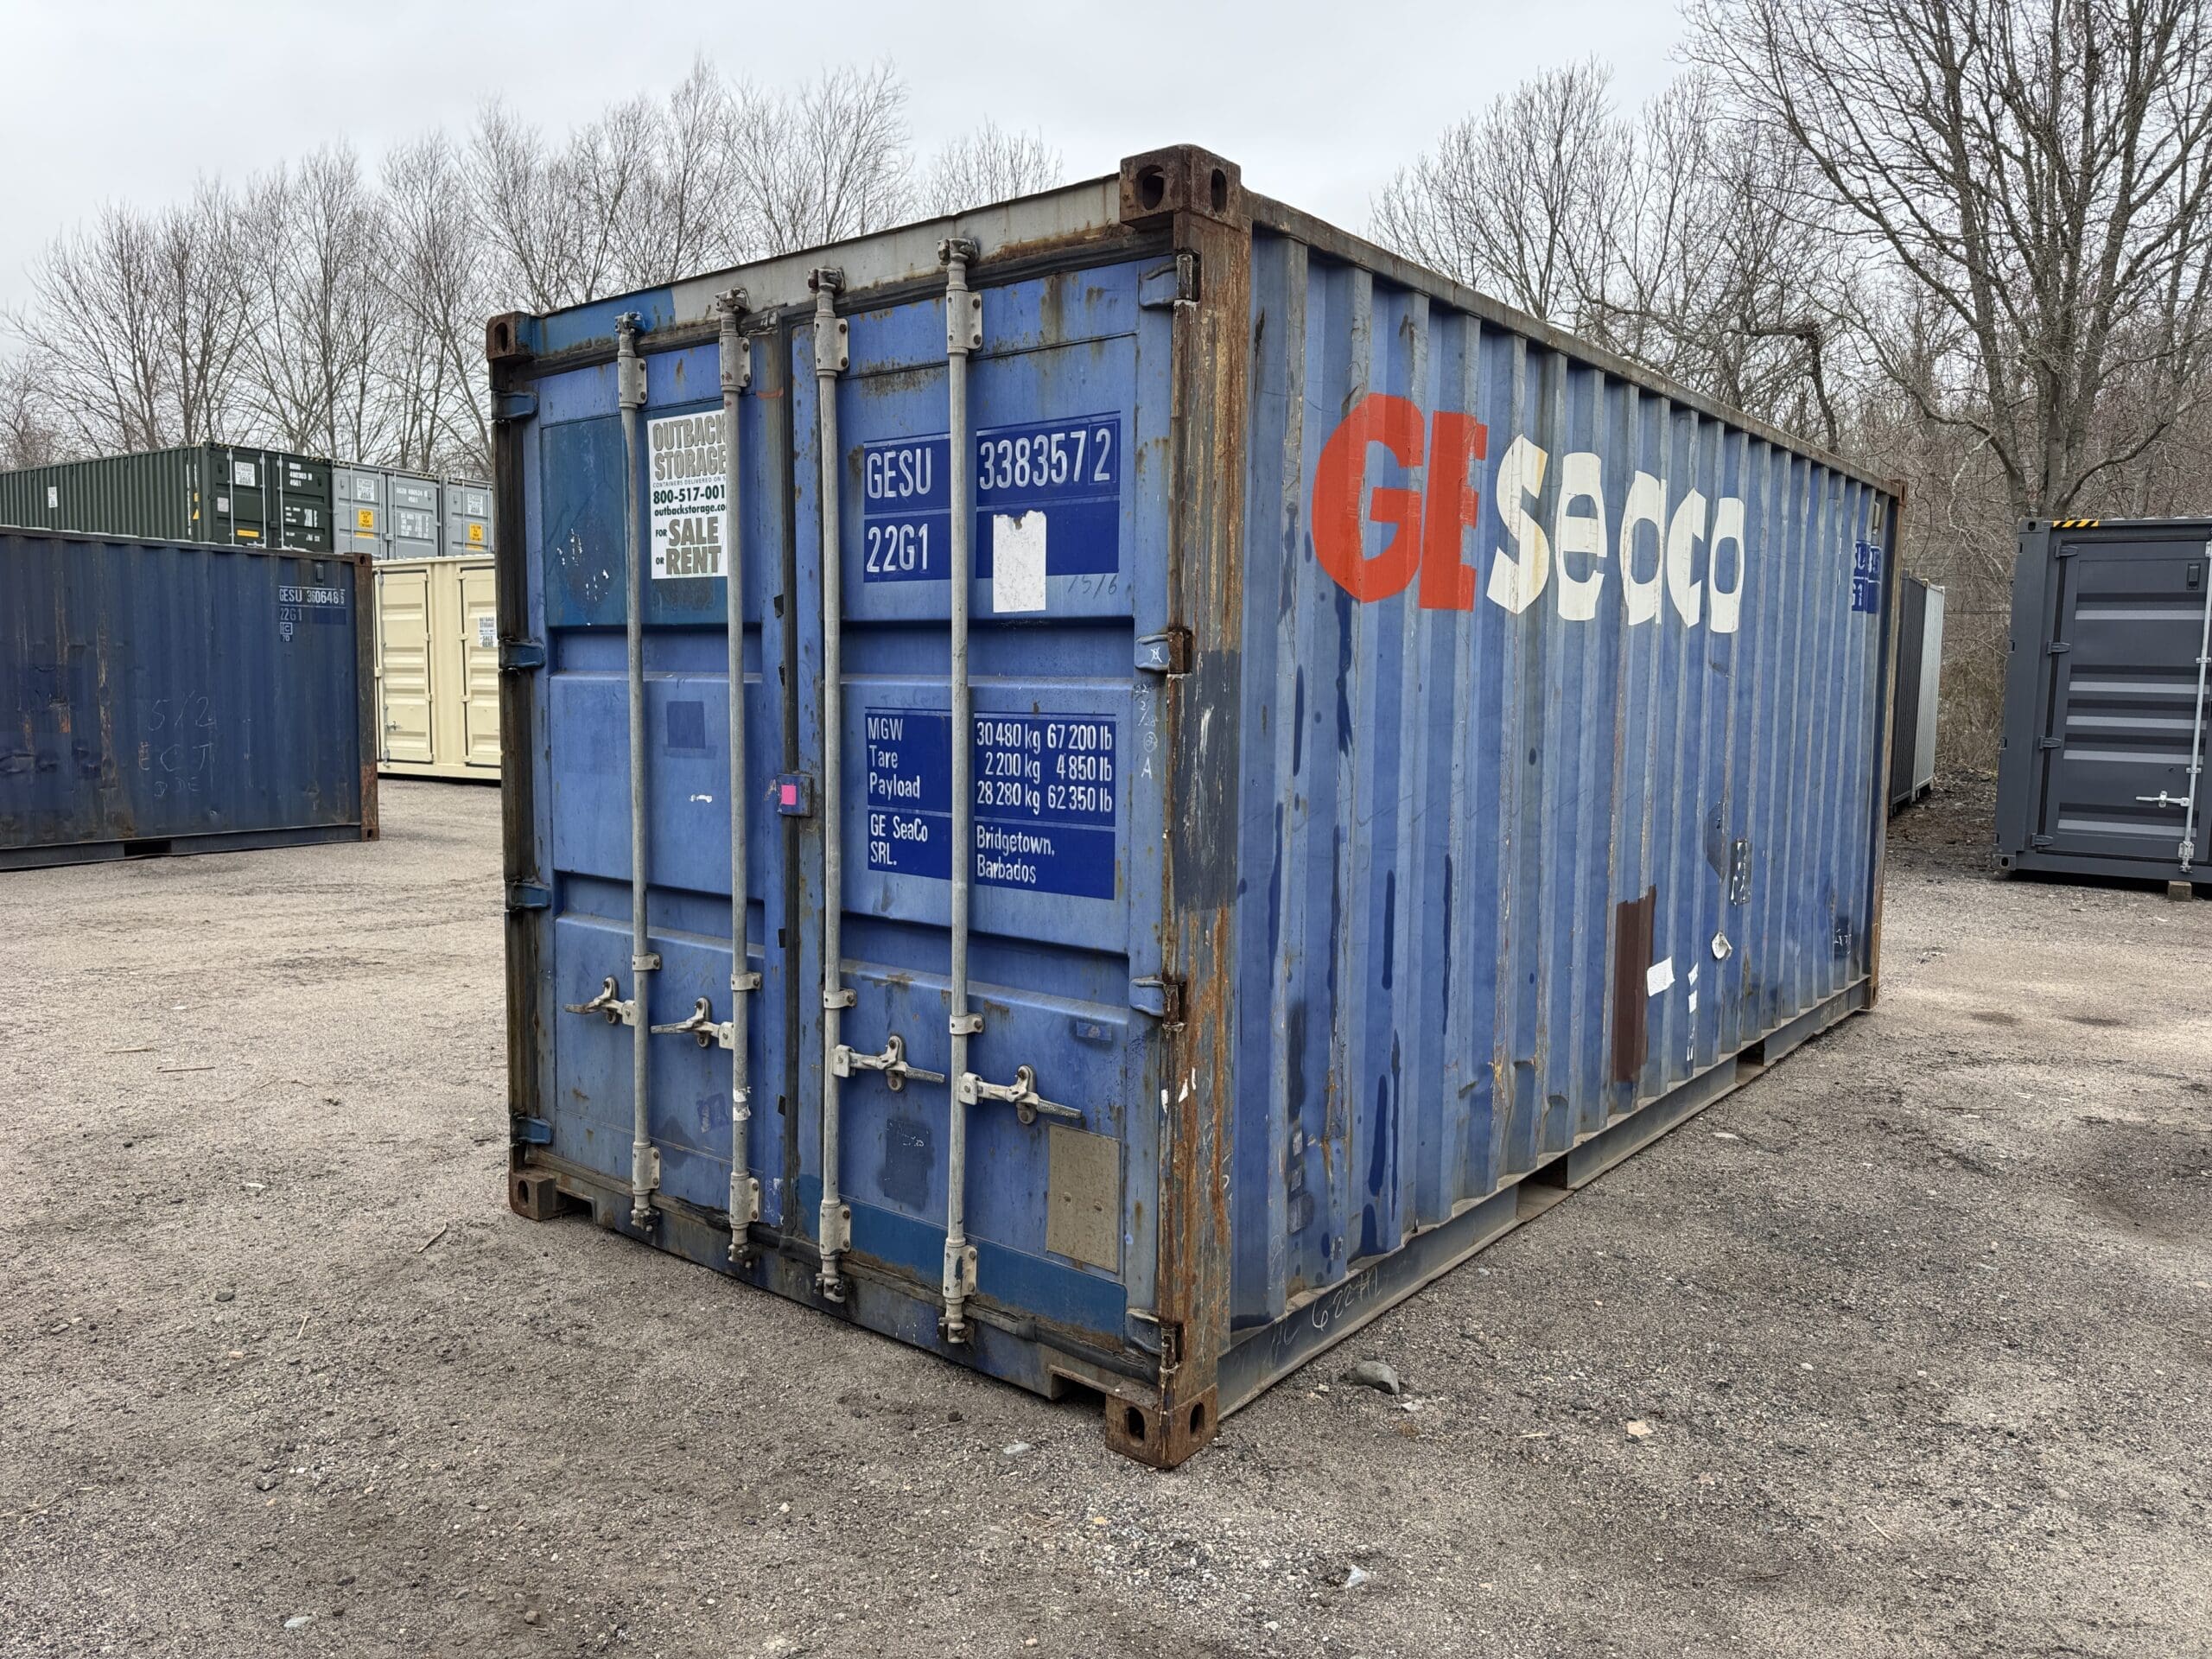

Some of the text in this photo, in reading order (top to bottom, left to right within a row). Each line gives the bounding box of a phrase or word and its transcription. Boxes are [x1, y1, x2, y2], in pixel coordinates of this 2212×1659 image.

[652, 414, 726, 451] OUTBACK
[654, 444, 726, 481] STORAGE
[867, 448, 932, 499] GESU
[653, 484, 725, 505] 800-517-001
[654, 504, 727, 516] outbackstorage.co
[655, 516, 718, 546] FOR SALE
[666, 545, 721, 575] RENT
[866, 523, 929, 573] 22G1
[279, 588, 302, 602] GESU
[280, 607, 302, 621] 22G1
[868, 717, 904, 742] MGW
[1024, 722, 1040, 753] kg
[1100, 724, 1112, 752] lb
[868, 745, 899, 769] Tare
[1024, 753, 1040, 785] kg
[1099, 757, 1112, 782] lb
[869, 773, 921, 801] Payload
[1024, 783, 1040, 816] kg
[1099, 787, 1112, 813] lb
[870, 814, 928, 843] GE SeaCo
[870, 842, 897, 866] SRL.
[976, 854, 1037, 884] Barbados
